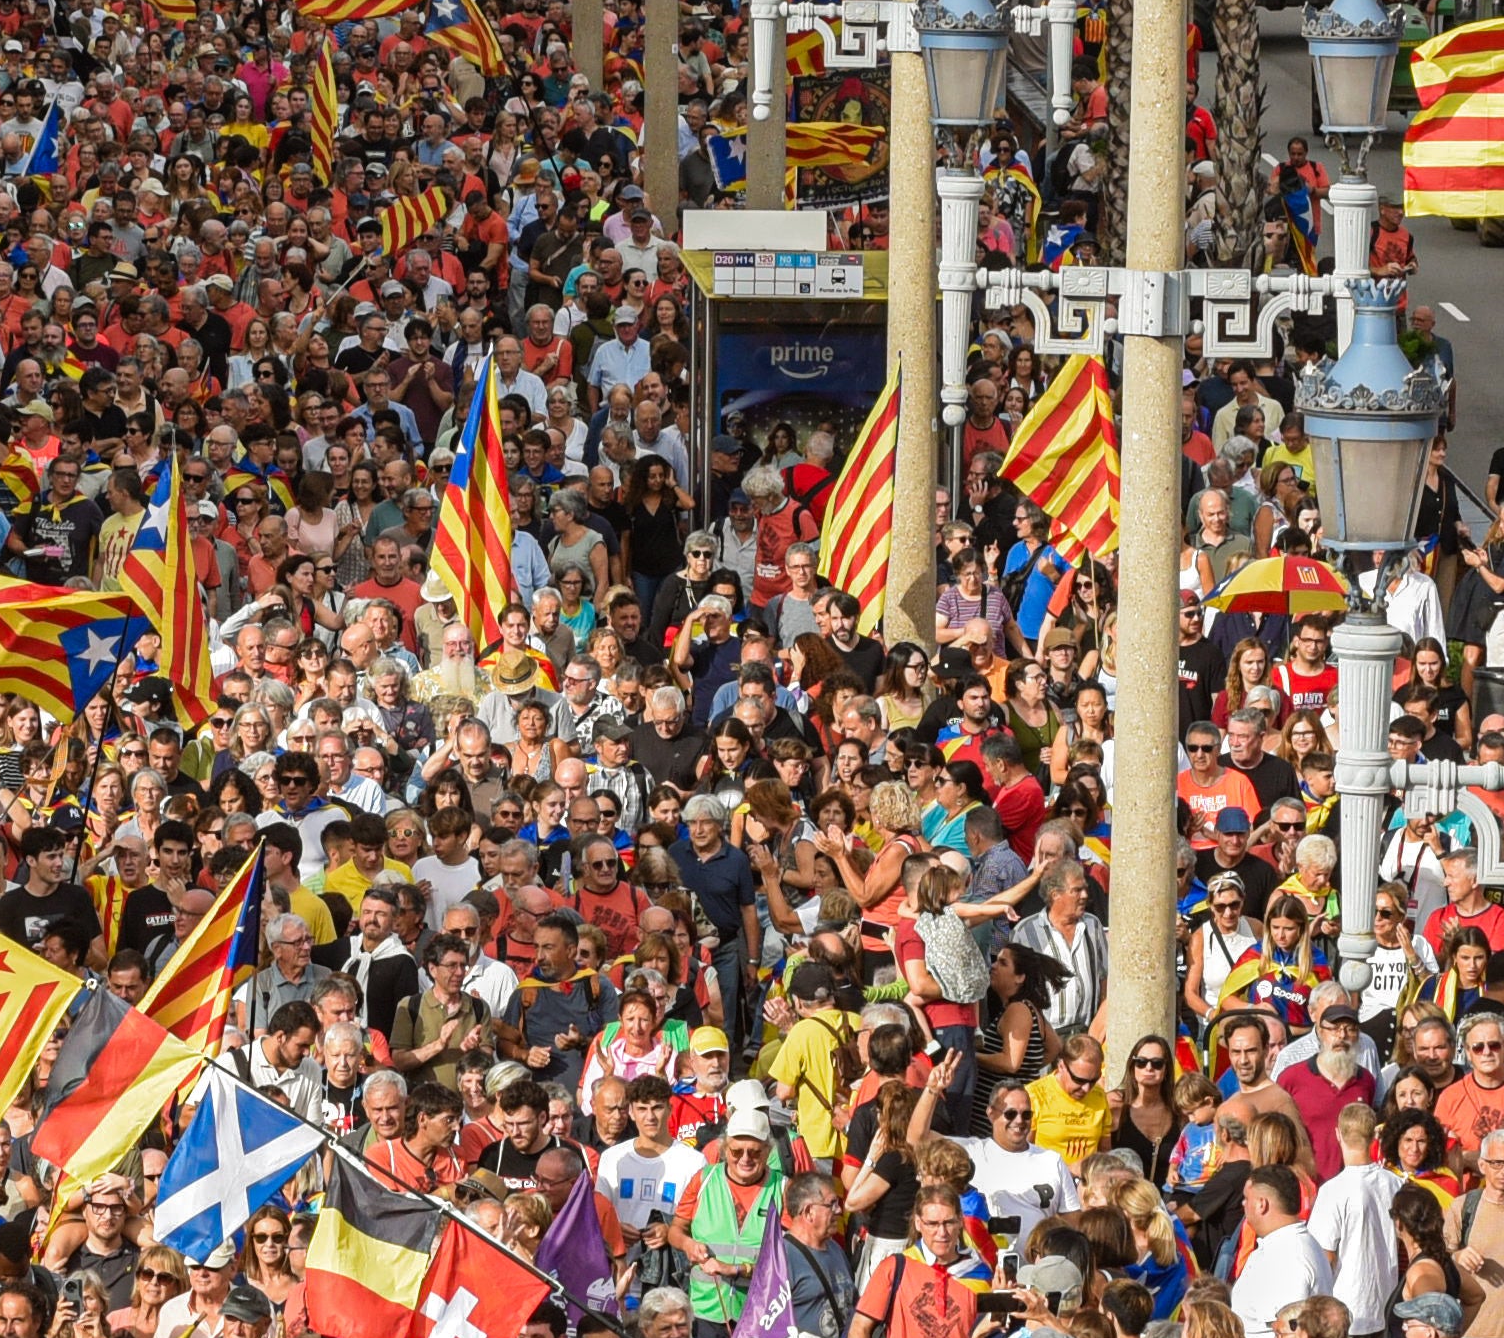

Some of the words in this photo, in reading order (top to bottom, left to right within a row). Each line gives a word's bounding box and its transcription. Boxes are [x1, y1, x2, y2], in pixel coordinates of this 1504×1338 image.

[715, 255, 734, 265] D20
[736, 256, 753, 265] H14
[770, 341, 835, 366] prime
[1374, 975, 1404, 990] CITY
[1273, 986, 1307, 1006] Spotify
